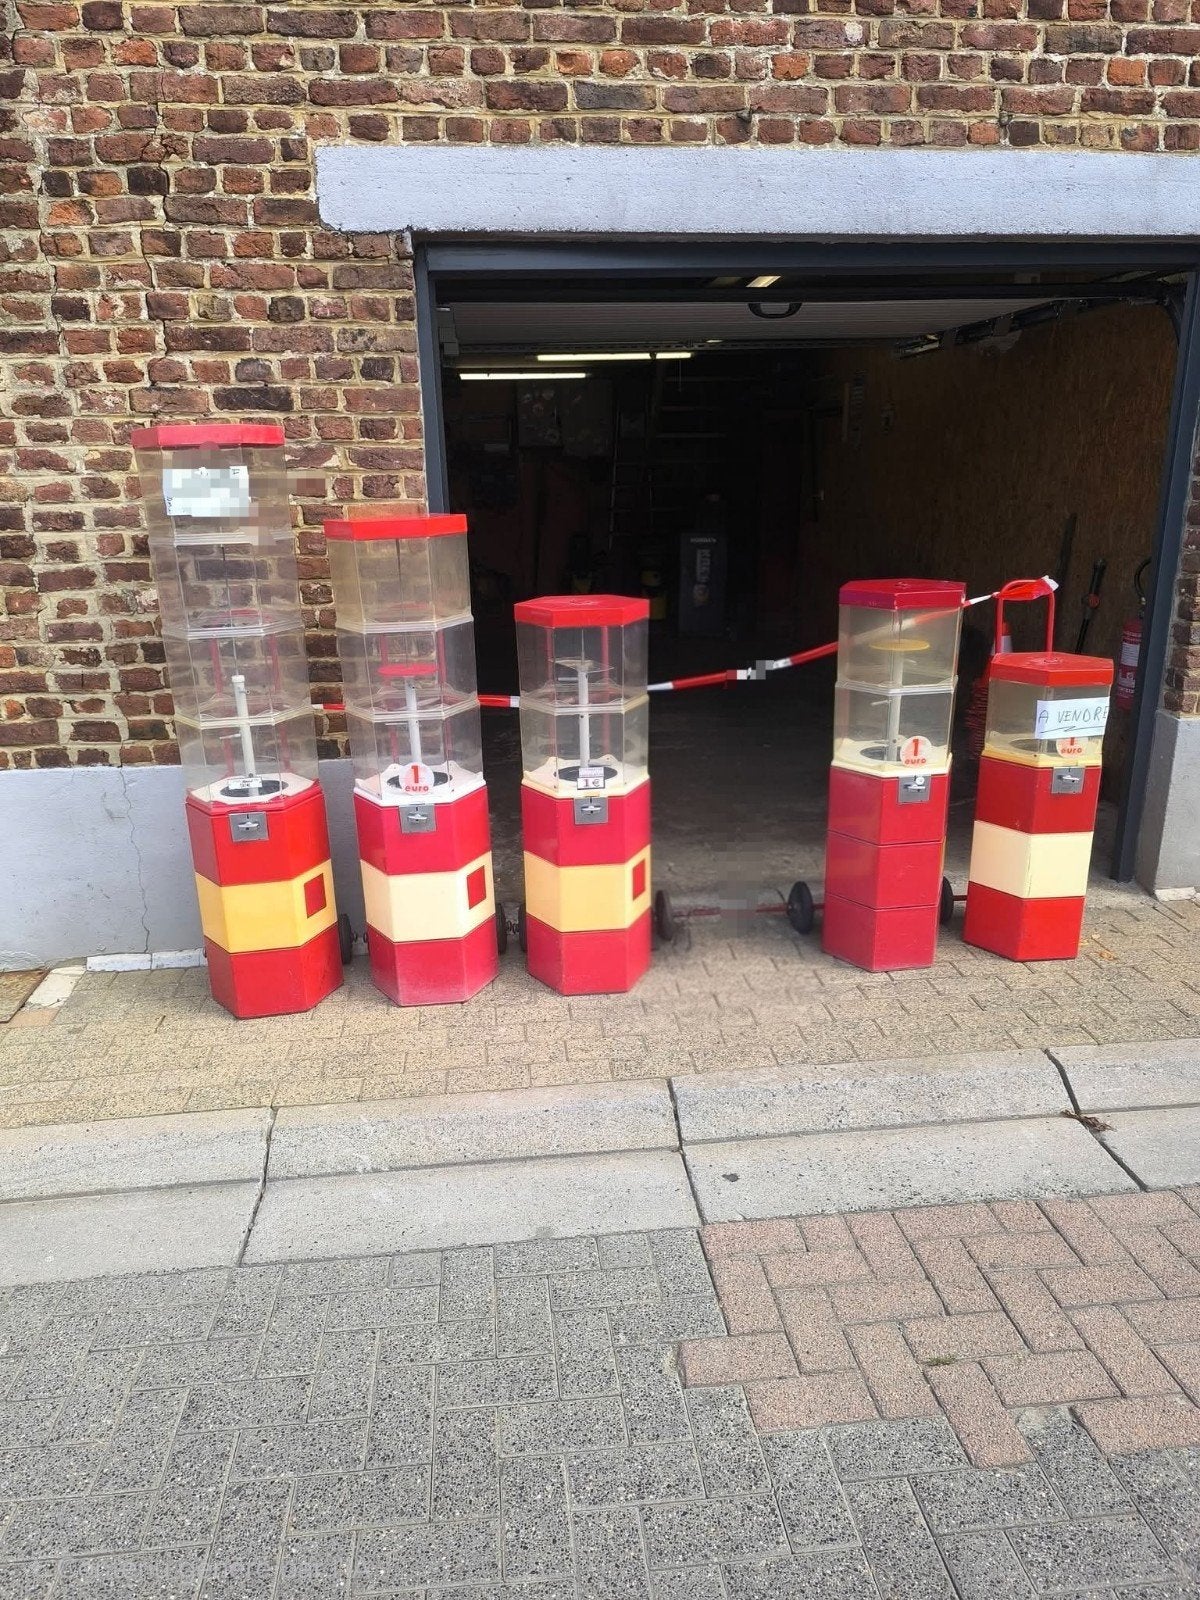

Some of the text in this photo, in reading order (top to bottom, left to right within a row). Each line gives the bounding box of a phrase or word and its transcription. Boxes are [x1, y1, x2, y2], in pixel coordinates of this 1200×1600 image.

[1038, 705, 1110, 724] A VENDRE
[912, 738, 919, 757] 1
[1060, 747, 1083, 755] euro
[904, 757, 927, 765] euro
[411, 765, 420, 784] 1
[404, 785, 430, 793] euro
